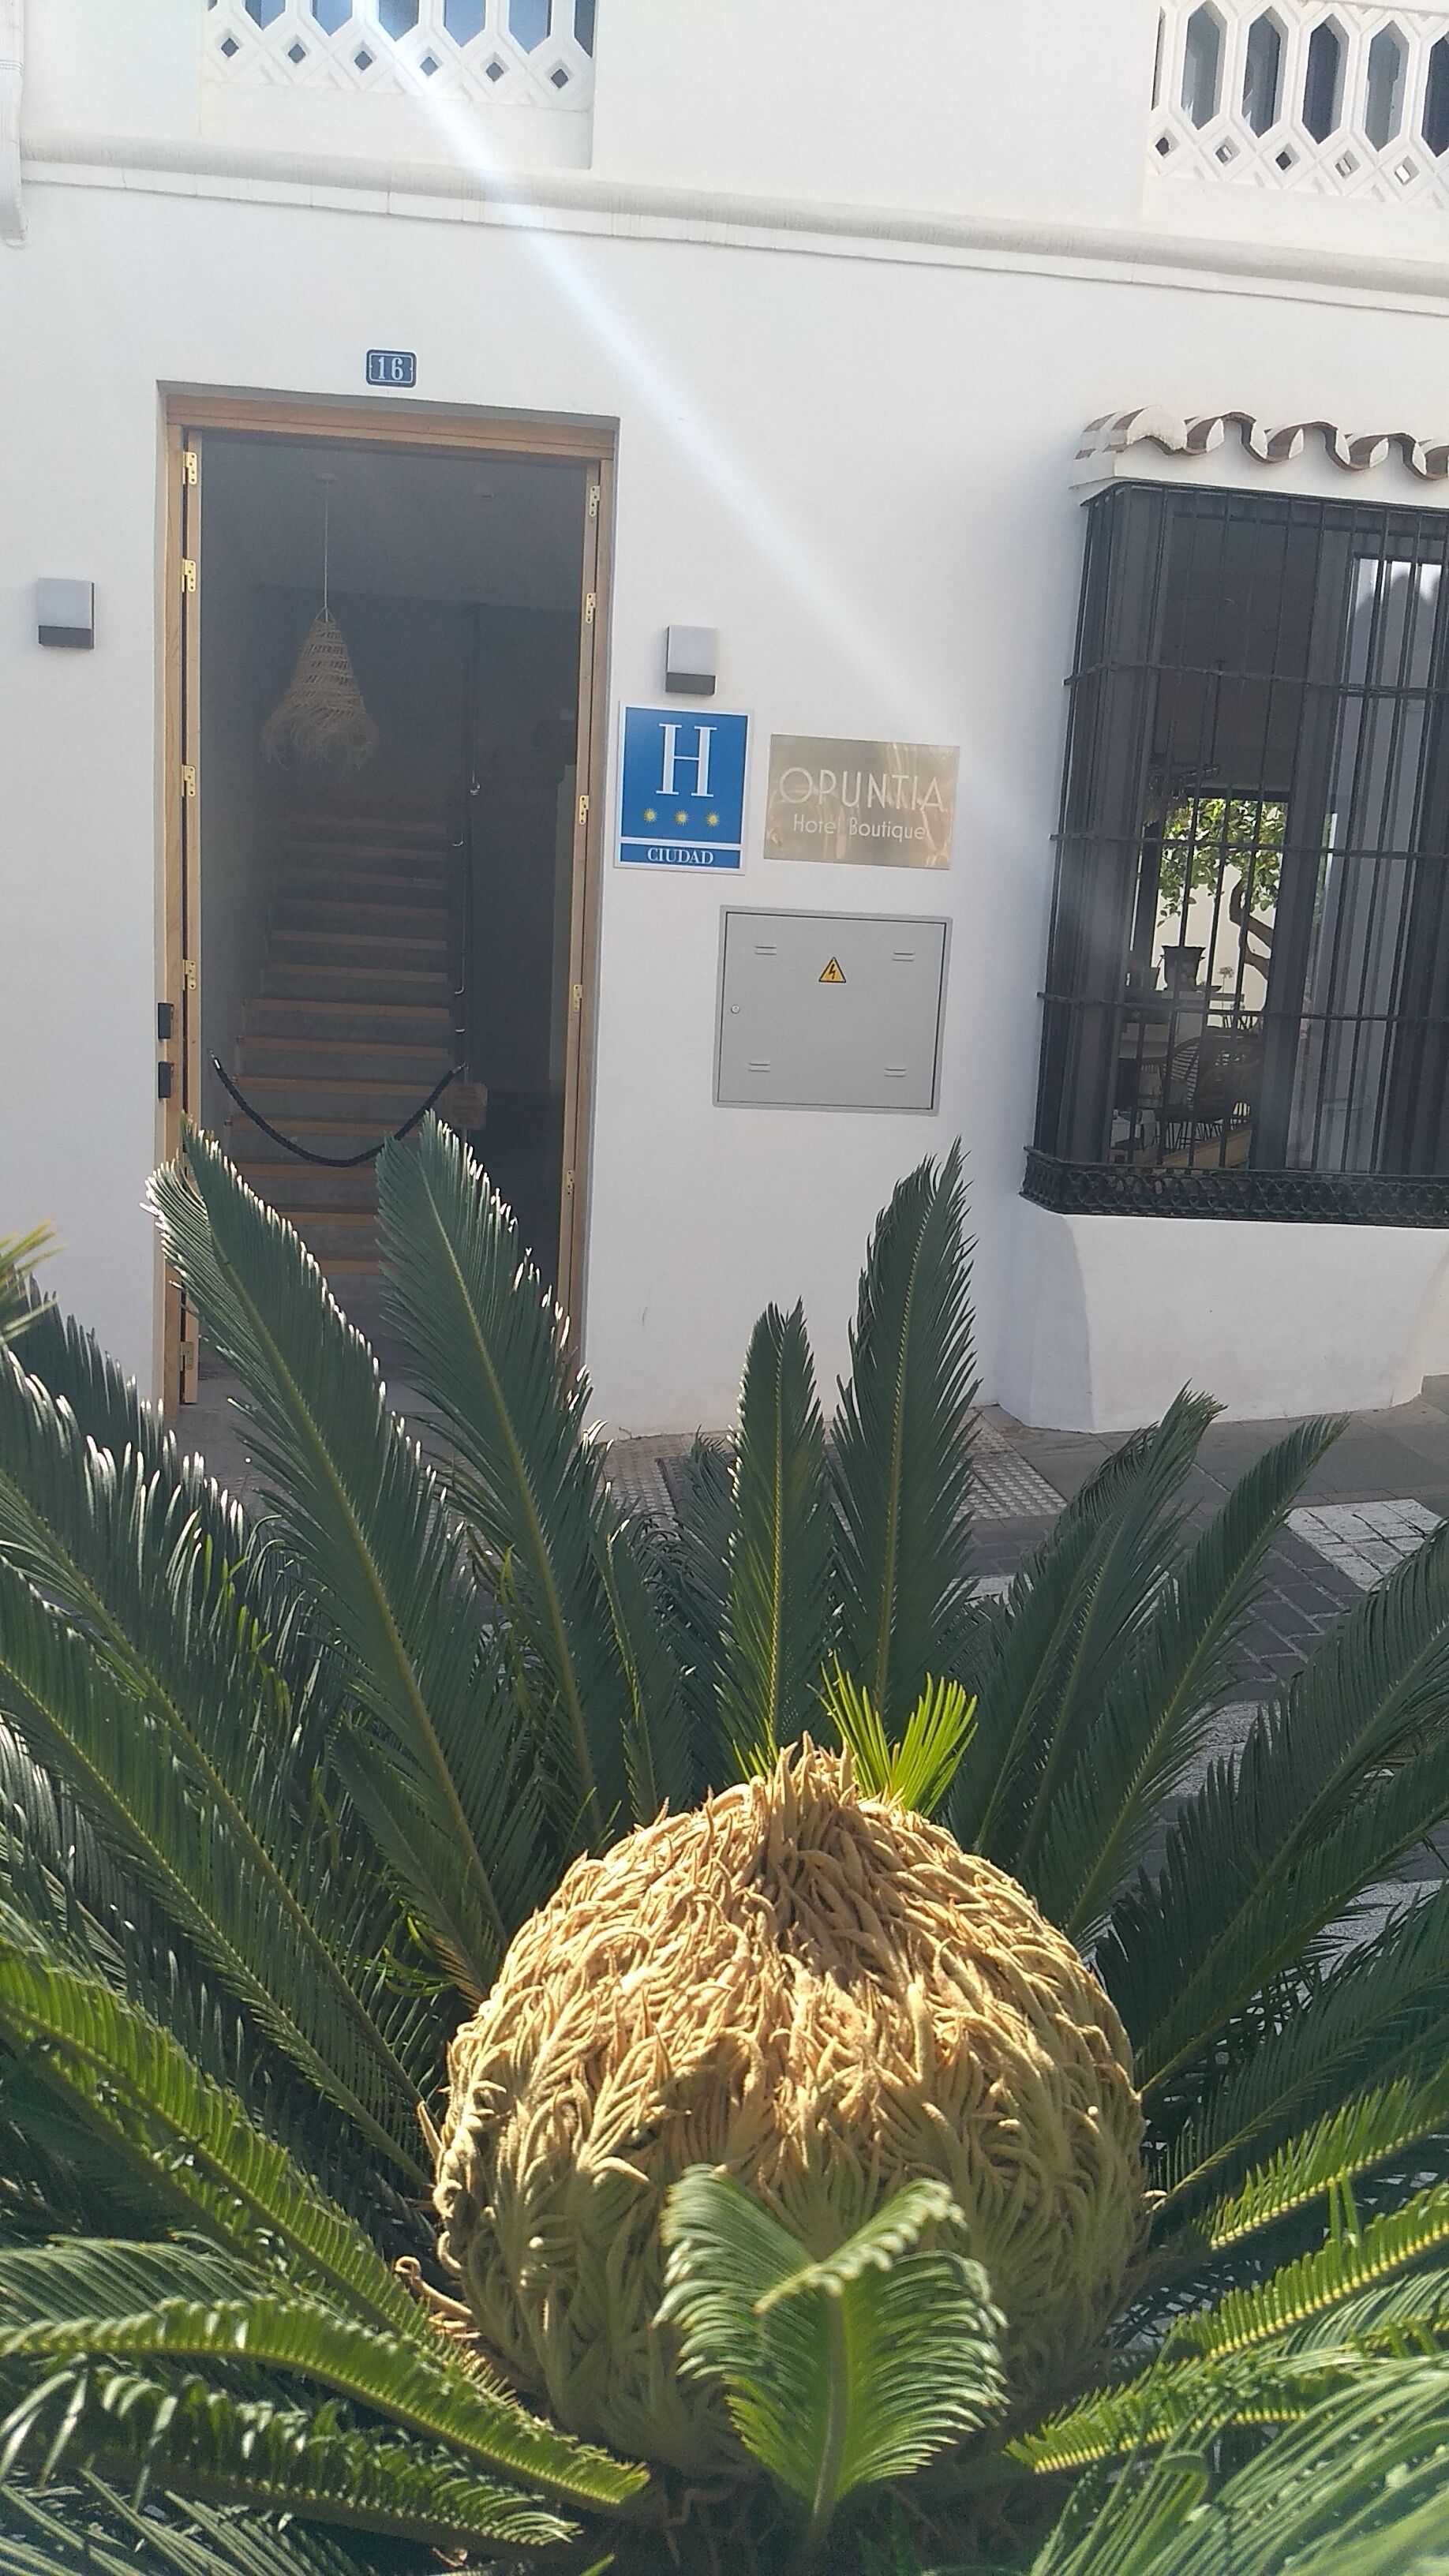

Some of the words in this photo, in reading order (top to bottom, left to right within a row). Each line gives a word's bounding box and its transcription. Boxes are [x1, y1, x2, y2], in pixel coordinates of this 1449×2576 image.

[377, 356, 404, 380] 16
[656, 723, 717, 797] H
[779, 766, 945, 812] OPUNTIA
[793, 813, 841, 834] Hotel
[848, 817, 925, 843] Boutique
[647, 847, 714, 865] CIUDAD
